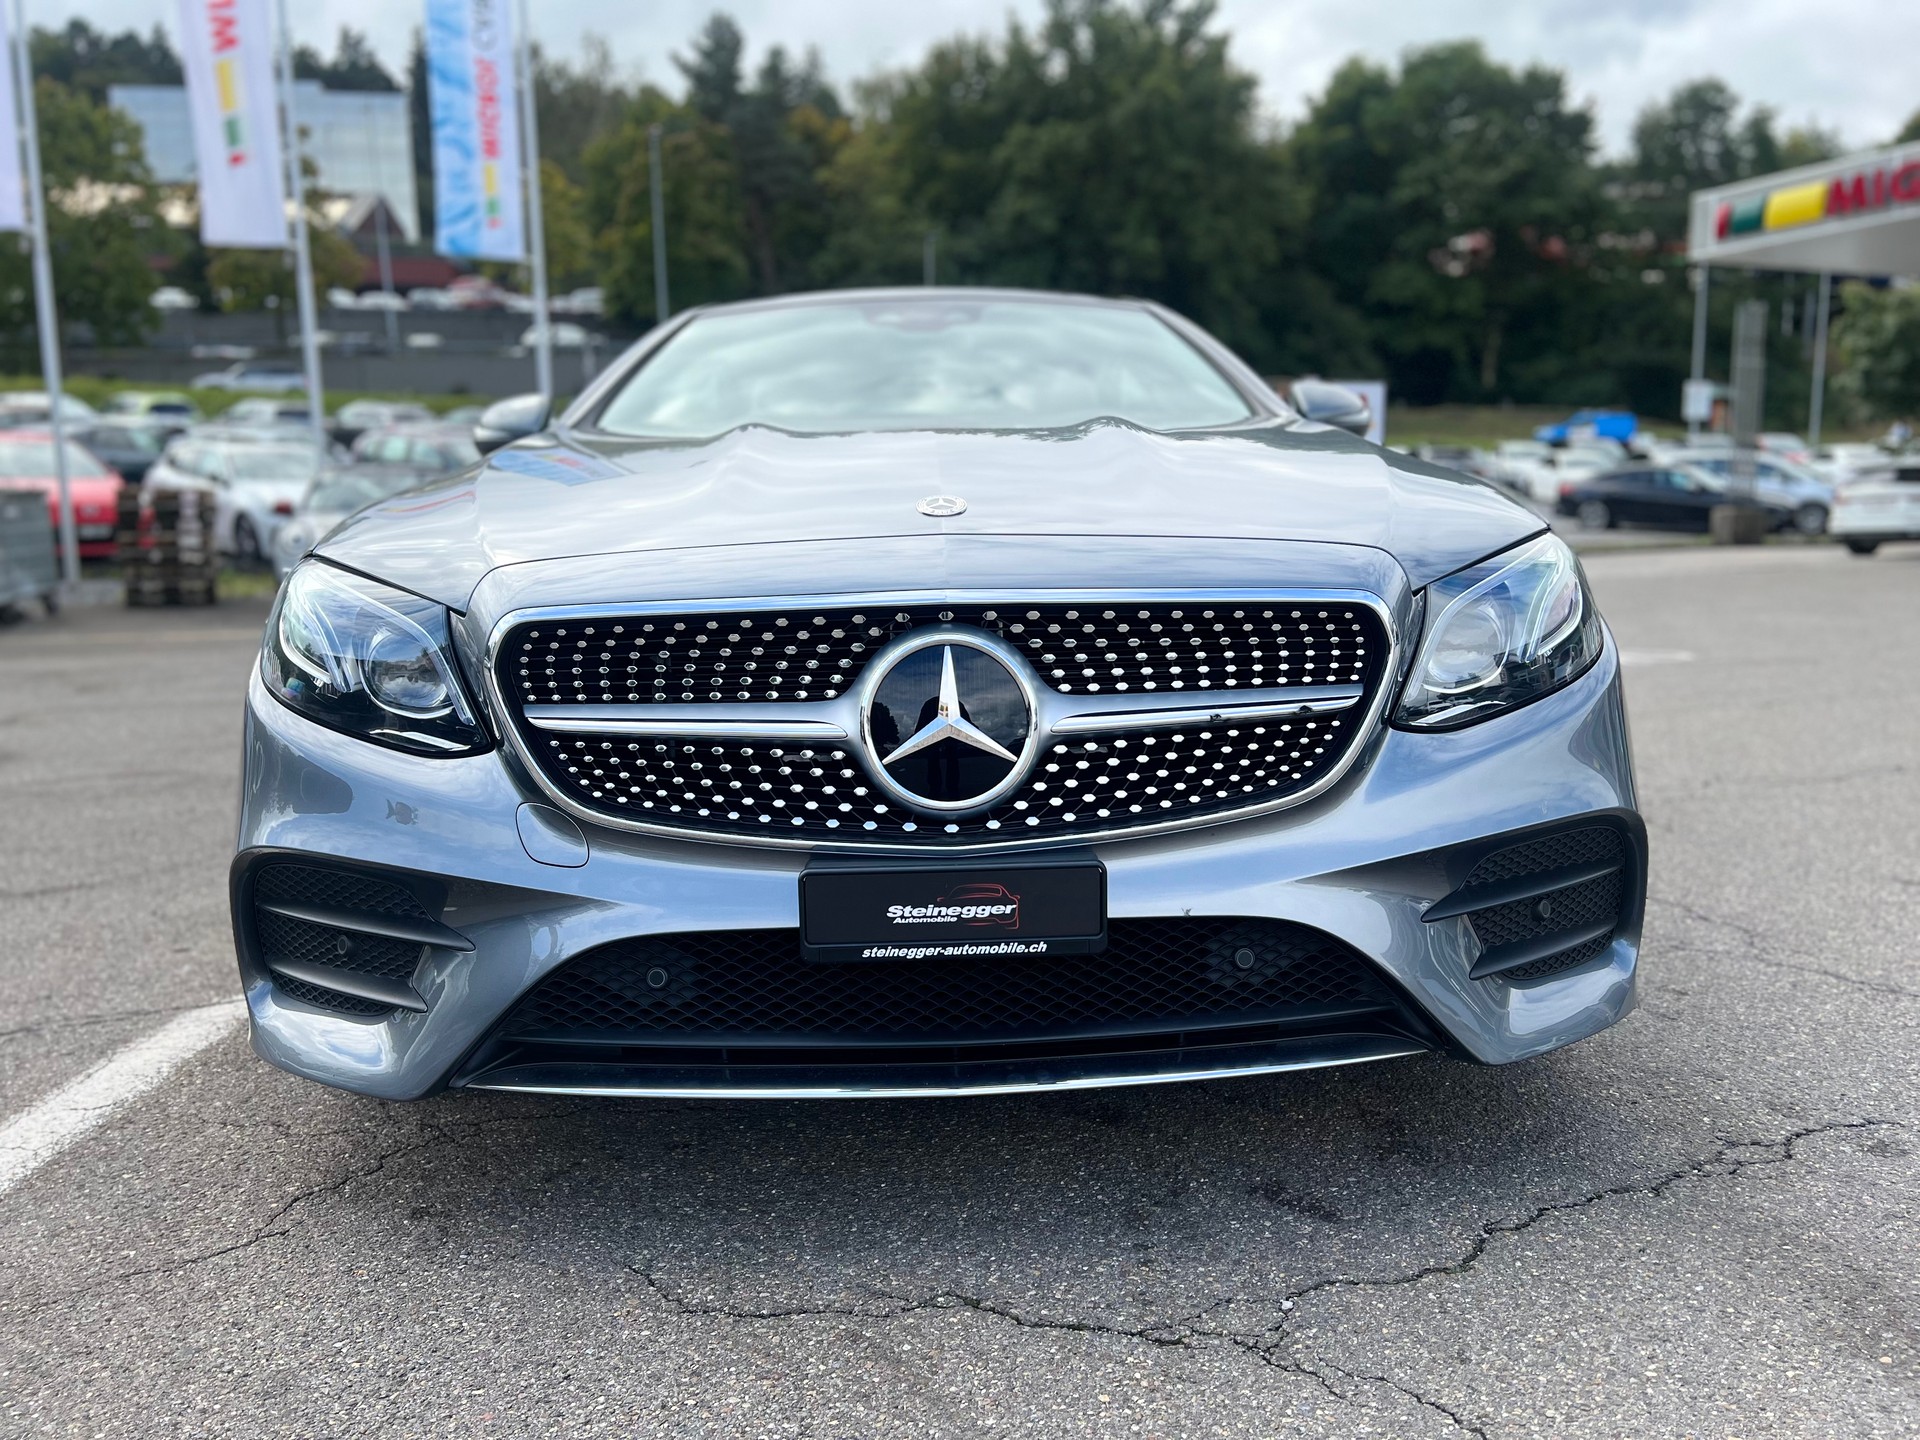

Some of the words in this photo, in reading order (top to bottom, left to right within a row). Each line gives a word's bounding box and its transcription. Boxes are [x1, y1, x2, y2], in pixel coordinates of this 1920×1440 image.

[886, 904, 1017, 918] Steinegger
[893, 915, 958, 924] Automobile
[862, 941, 1048, 959] steinegger-automobile.ch
